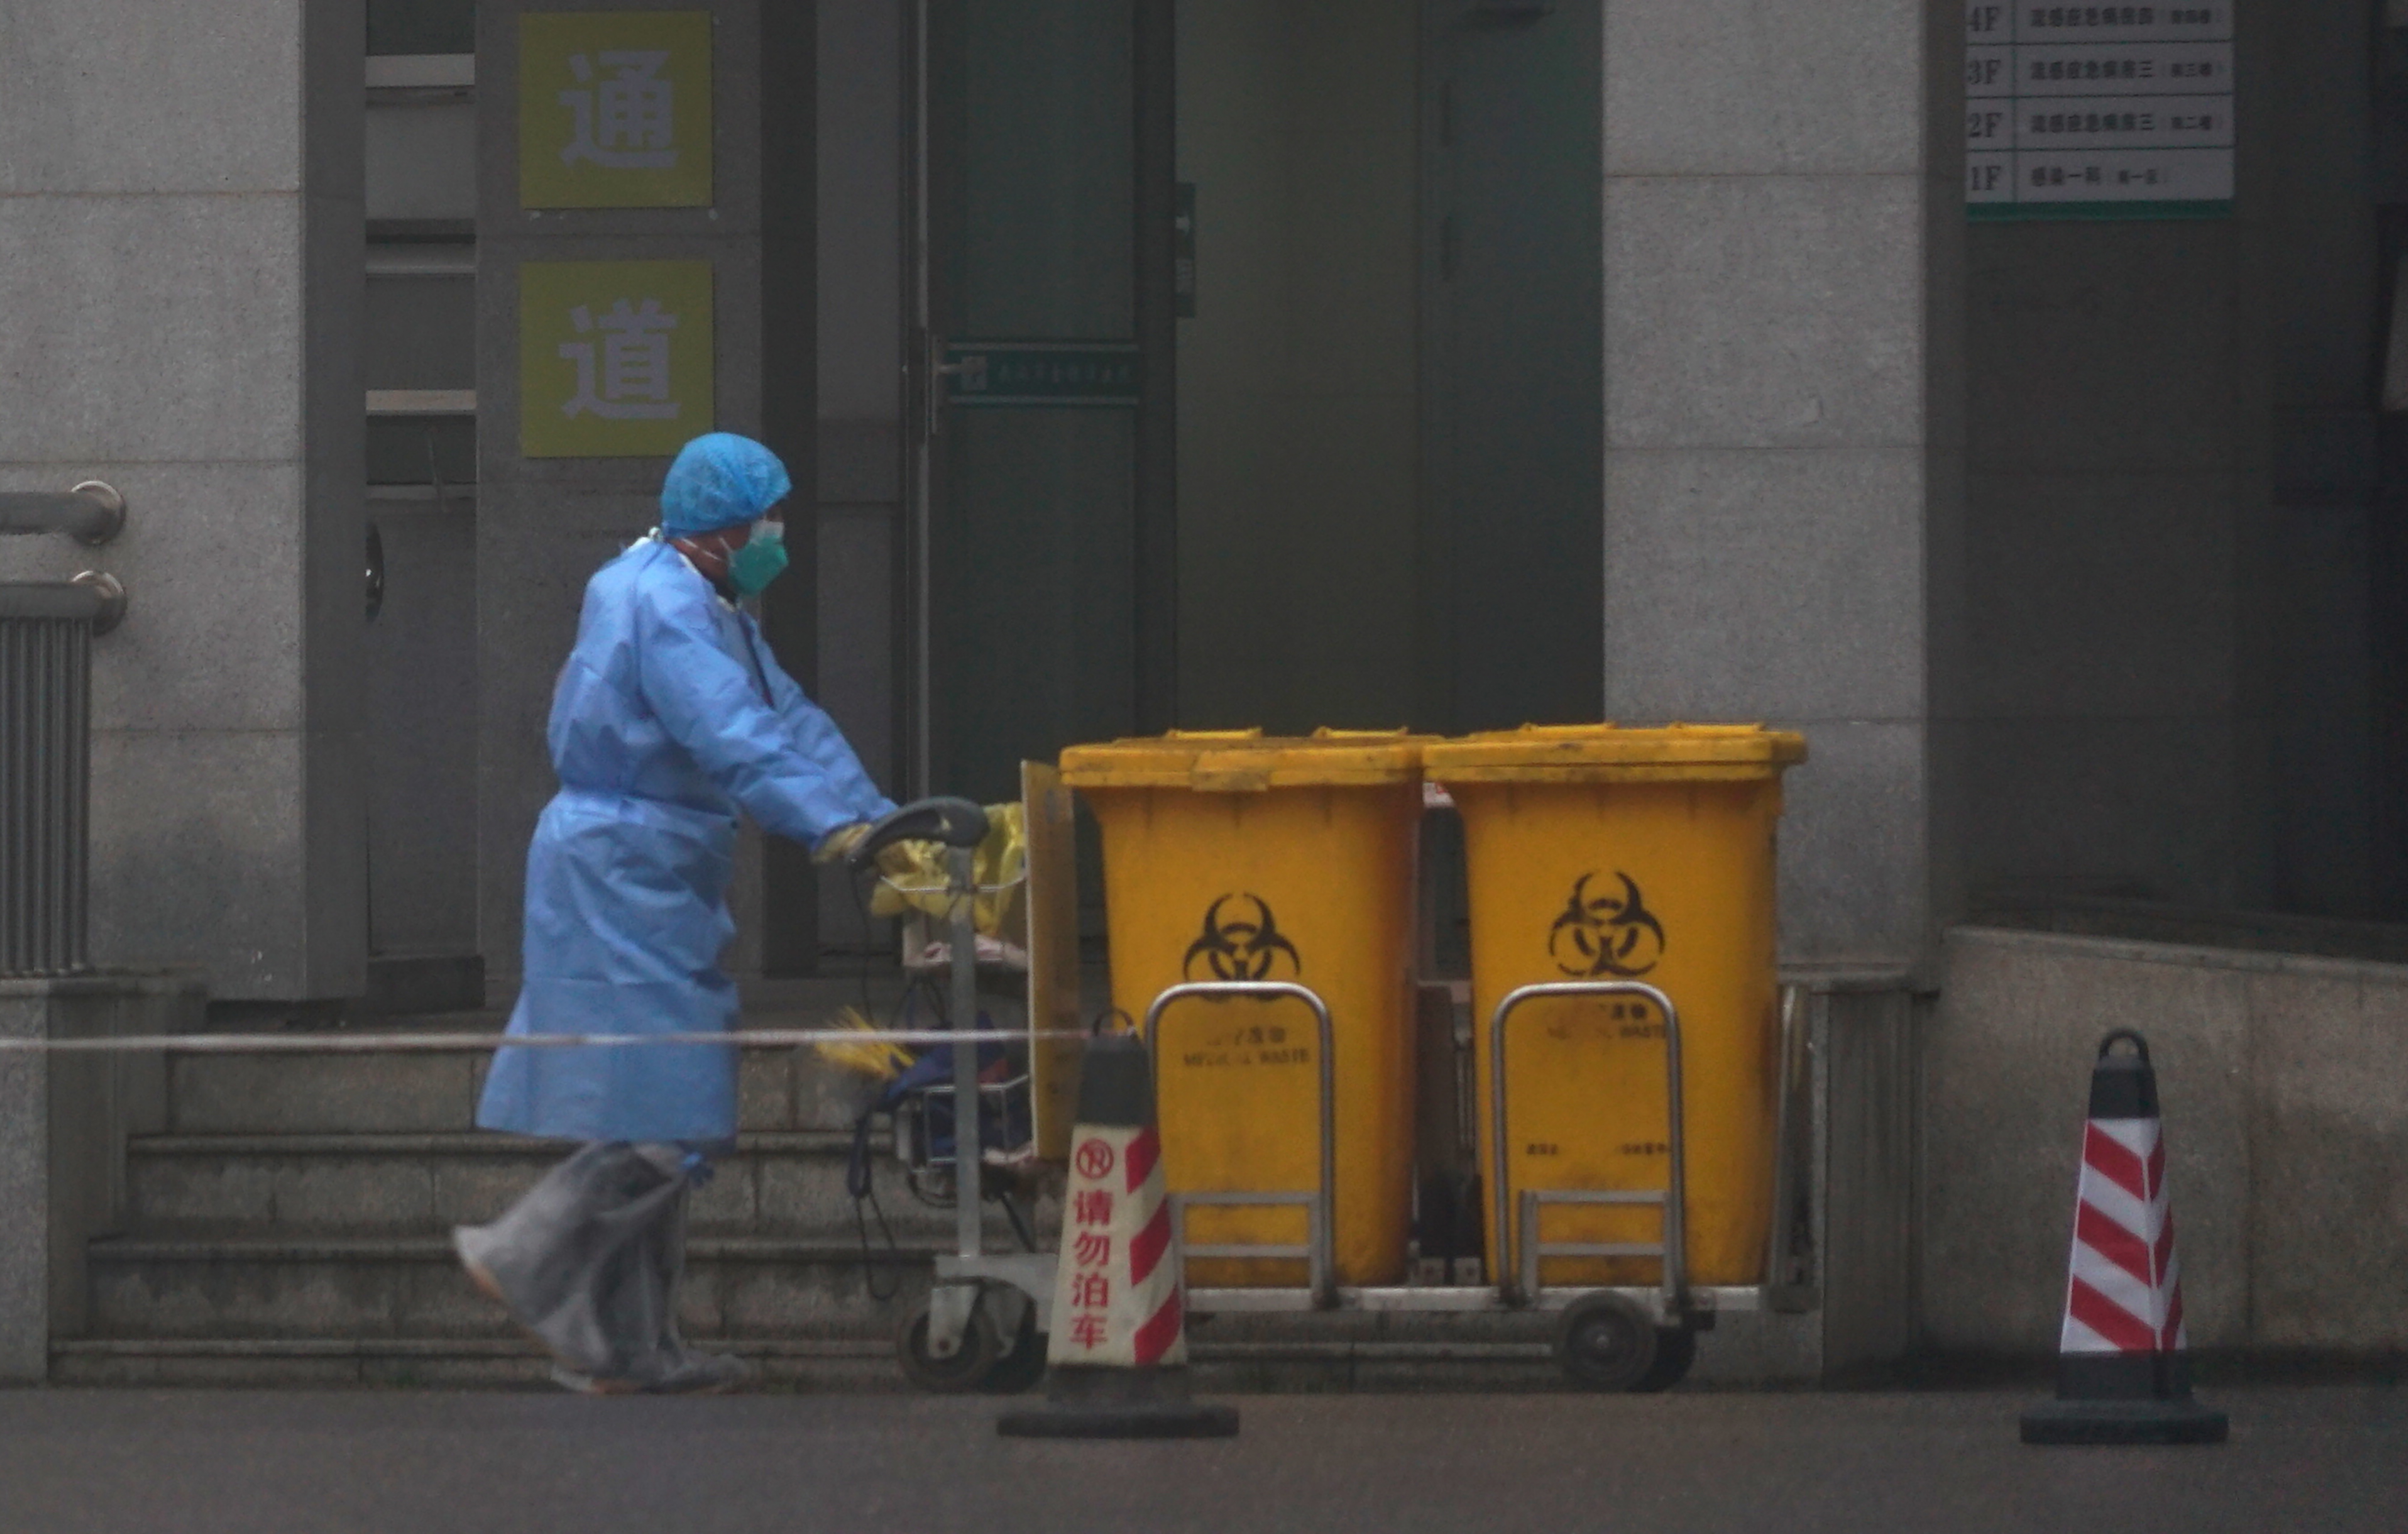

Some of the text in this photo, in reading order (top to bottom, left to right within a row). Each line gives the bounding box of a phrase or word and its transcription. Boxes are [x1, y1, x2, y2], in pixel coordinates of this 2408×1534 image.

[1969, 7, 1999, 32] 4F
[1969, 59, 2001, 85] 3F
[1969, 113, 2002, 138] 2F
[1971, 166, 2001, 191] 1F
[1070, 1190, 1113, 1349] 请勿泊车
